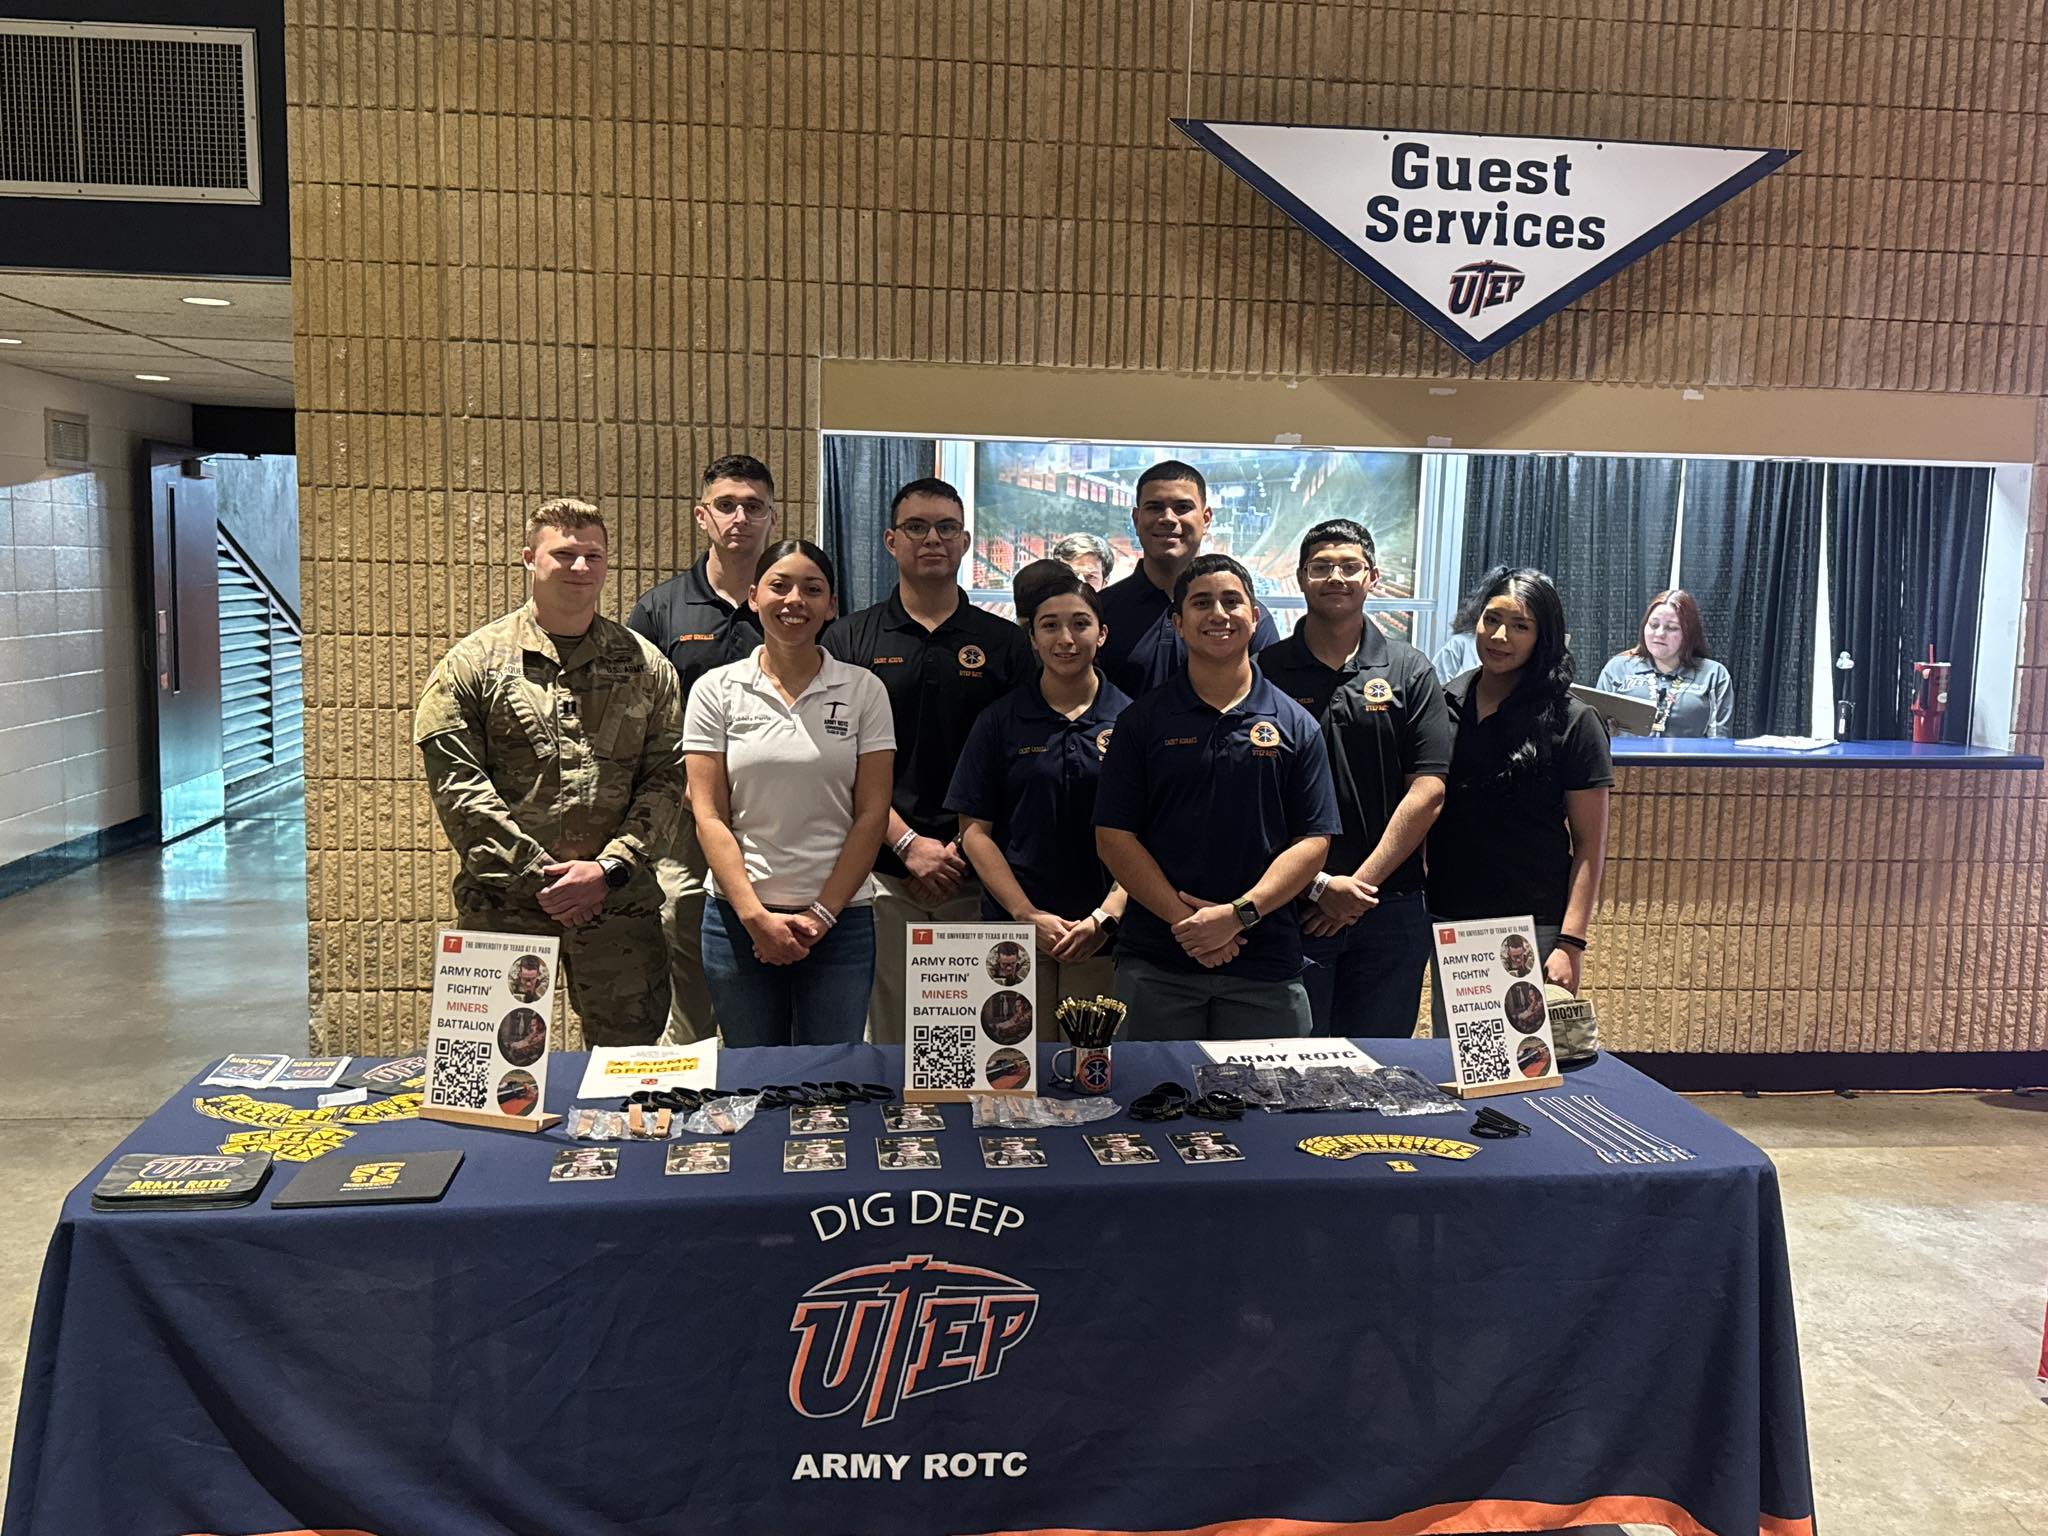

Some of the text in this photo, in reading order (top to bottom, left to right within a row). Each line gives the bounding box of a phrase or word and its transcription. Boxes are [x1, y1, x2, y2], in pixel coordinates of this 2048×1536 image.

[1391, 142, 1572, 197] Guest
[1365, 195, 1607, 251] Services
[1448, 259, 1526, 319] UTEP
[625, 664, 644, 672] ARMY
[936, 932, 945, 940] THE
[947, 932, 976, 940] UNIVERSITY
[977, 932, 984, 940] OF
[985, 932, 1000, 940] TEXAS
[1002, 932, 1008, 940] AT
[1009, 932, 1014, 940] EL
[474, 942, 501, 951] UNIVERSITY
[510, 944, 524, 952] TEXAS
[538, 946, 551, 954] PASO
[911, 957, 979, 966] ARMY ROTC
[1443, 952, 1495, 965] ARMY ROTC
[440, 966, 502, 979] ARMY ROTC
[921, 973, 969, 982] FIGHTIN'
[1452, 968, 1490, 980] FIGHTIN'
[447, 984, 492, 996] FIGHTIN'
[922, 990, 968, 999] MINERS
[1456, 985, 1492, 996] MINERS
[446, 1001, 488, 1013] MINERS
[913, 1006, 976, 1016] BATTALION
[1452, 1000, 1501, 1014] BATTALION
[437, 1018, 495, 1032] BATTALION
[637, 1057, 697, 1066] ARMY
[1226, 1050, 1357, 1063] ARMY ROTC
[609, 1064, 694, 1074] OFFICER
[138, 1155, 245, 1179] UTEP
[127, 1178, 232, 1190] ARMY ROTC
[810, 1190, 1025, 1242] DIG DEEP
[789, 1254, 1039, 1428] UTEP
[792, 1451, 1028, 1481] ARMY ROTC
